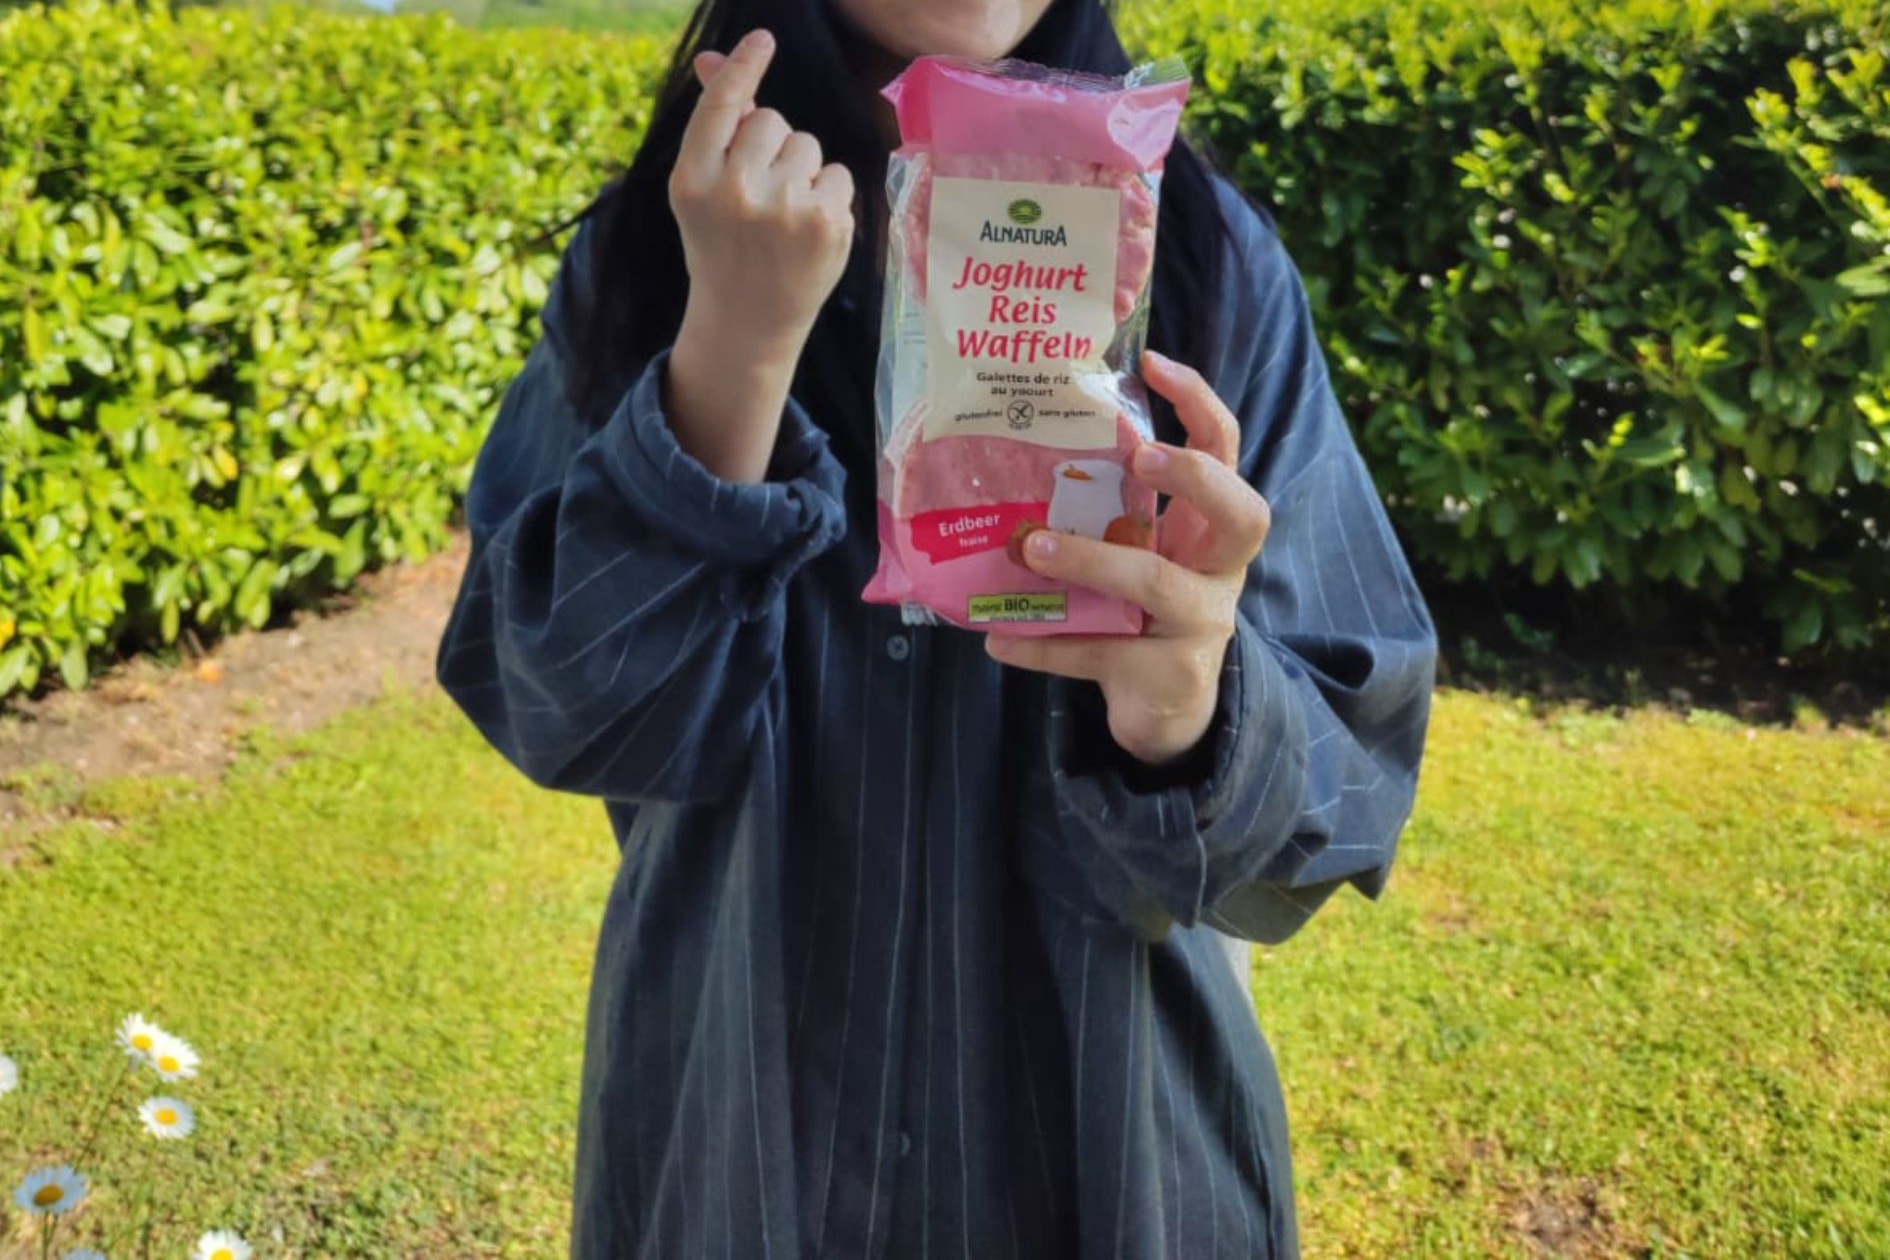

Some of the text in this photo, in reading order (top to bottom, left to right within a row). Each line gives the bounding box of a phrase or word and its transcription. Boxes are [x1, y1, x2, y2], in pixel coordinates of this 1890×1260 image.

[953, 256, 1088, 292] Joghurt
[989, 295, 1057, 324] Reis
[956, 329, 1092, 363] Waffeln
[976, 371, 1070, 385] Galettes de riz
[991, 386, 1054, 398] au yaourt
[938, 513, 1001, 538] Erdbeer
